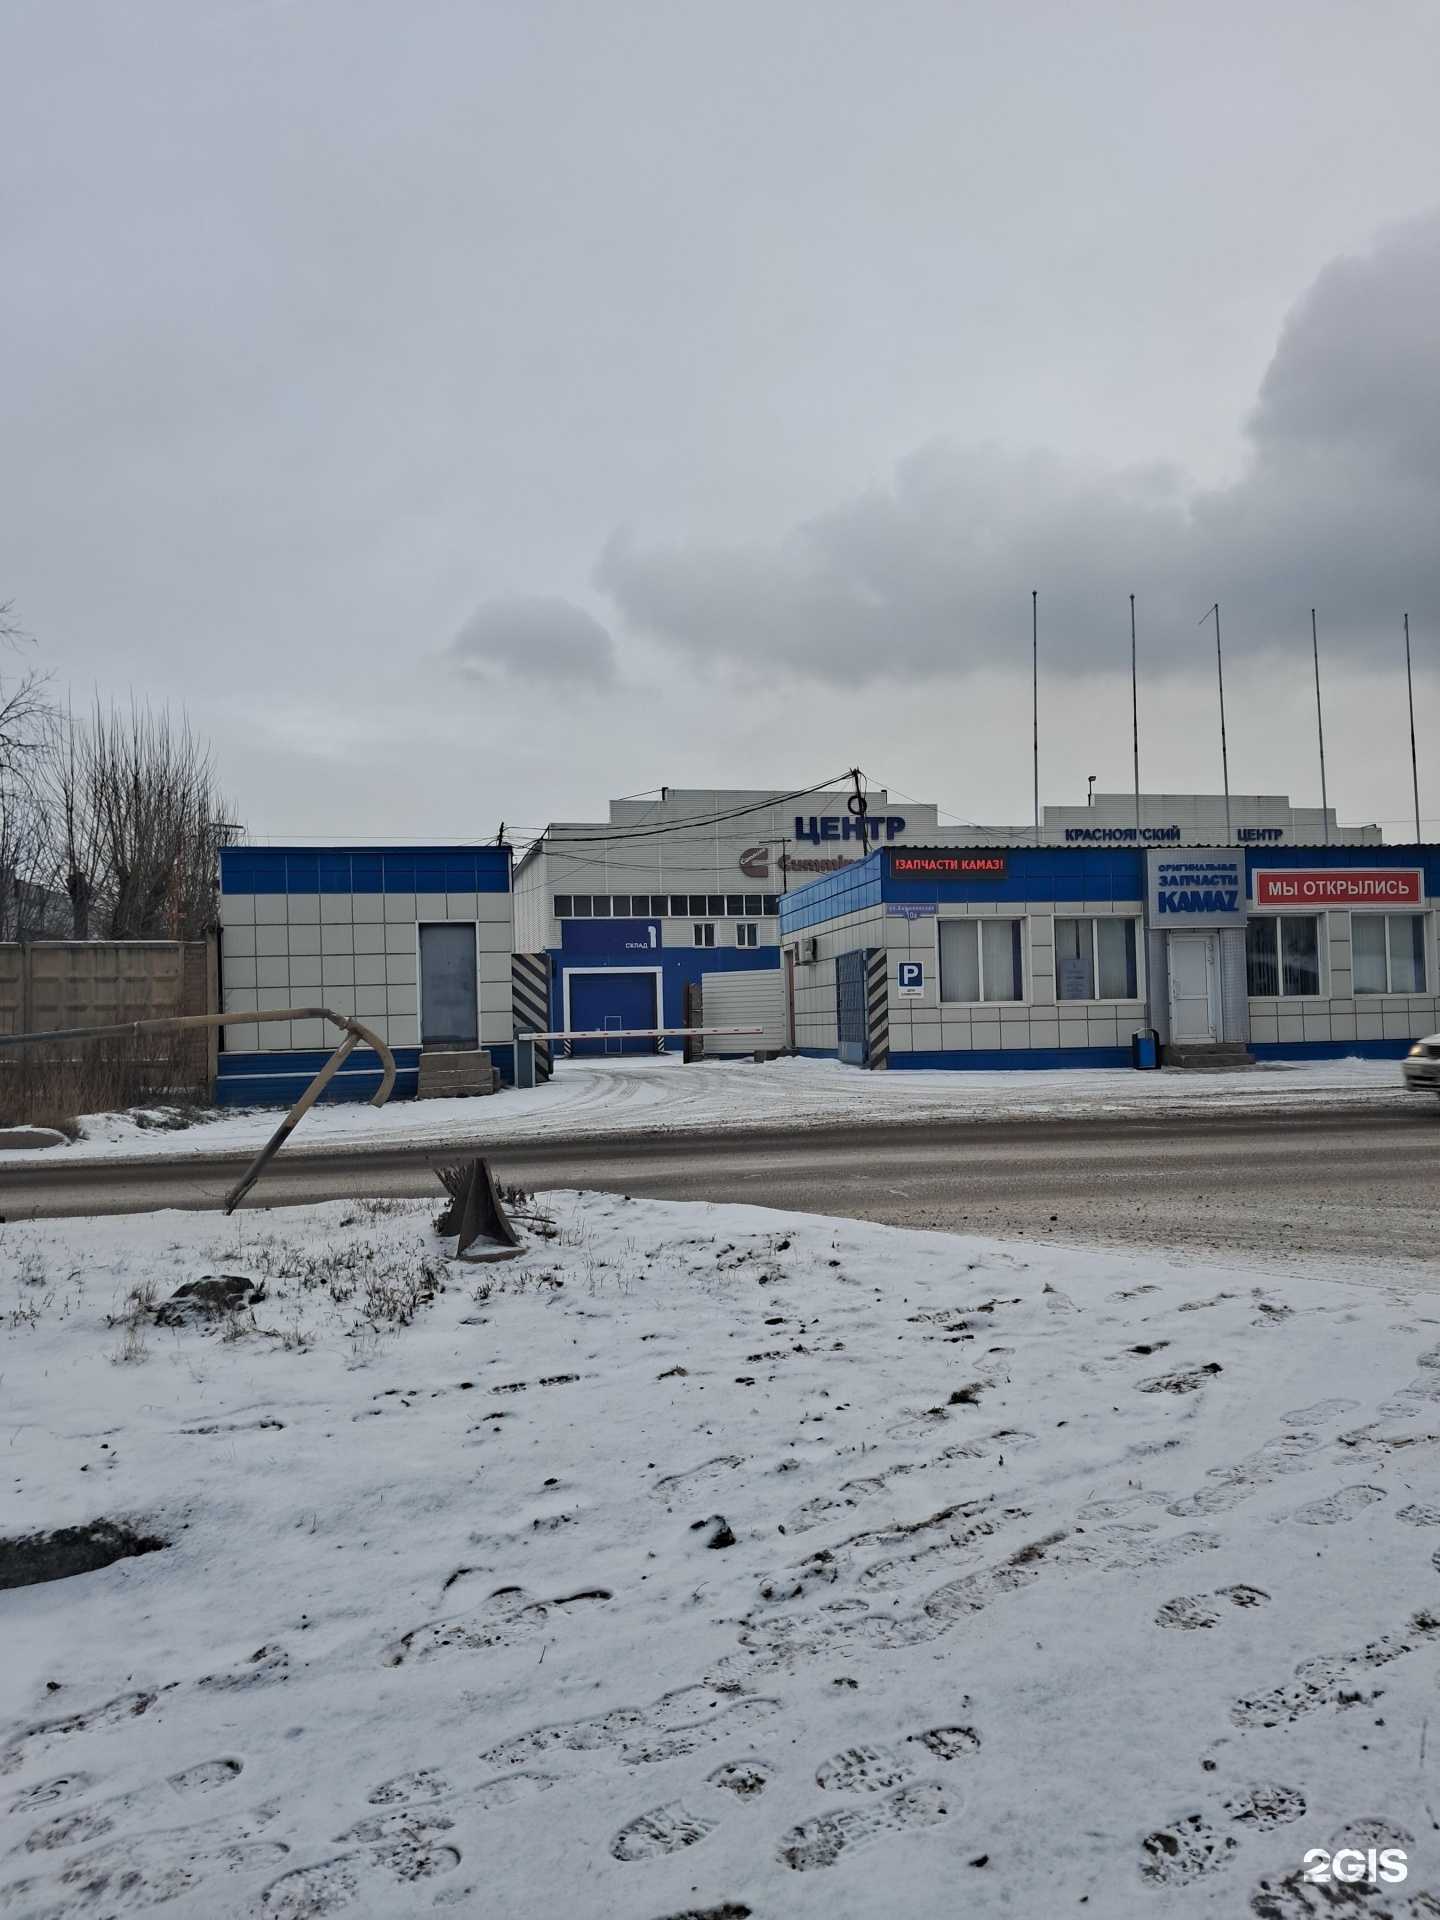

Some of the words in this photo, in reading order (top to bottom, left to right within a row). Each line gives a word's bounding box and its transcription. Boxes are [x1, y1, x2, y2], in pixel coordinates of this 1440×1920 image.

[795, 816, 906, 845] ЦЕНТР
[1237, 828, 1284, 843] ЦЕНТР
[895, 859, 958, 870] !ЗАПЧАСТИ
[961, 859, 1004, 870] КАМАЗ!
[1158, 863, 1238, 872] ОРИГИНАЛЬНЫЕ
[1159, 874, 1239, 887] ЗАПЧАСТИ
[1268, 881, 1298, 896] МЫ
[1303, 880, 1410, 896] ОТКРЫЛИСЬ
[1158, 890, 1239, 914] KAMAZ
[648, 926, 656, 948] 1
